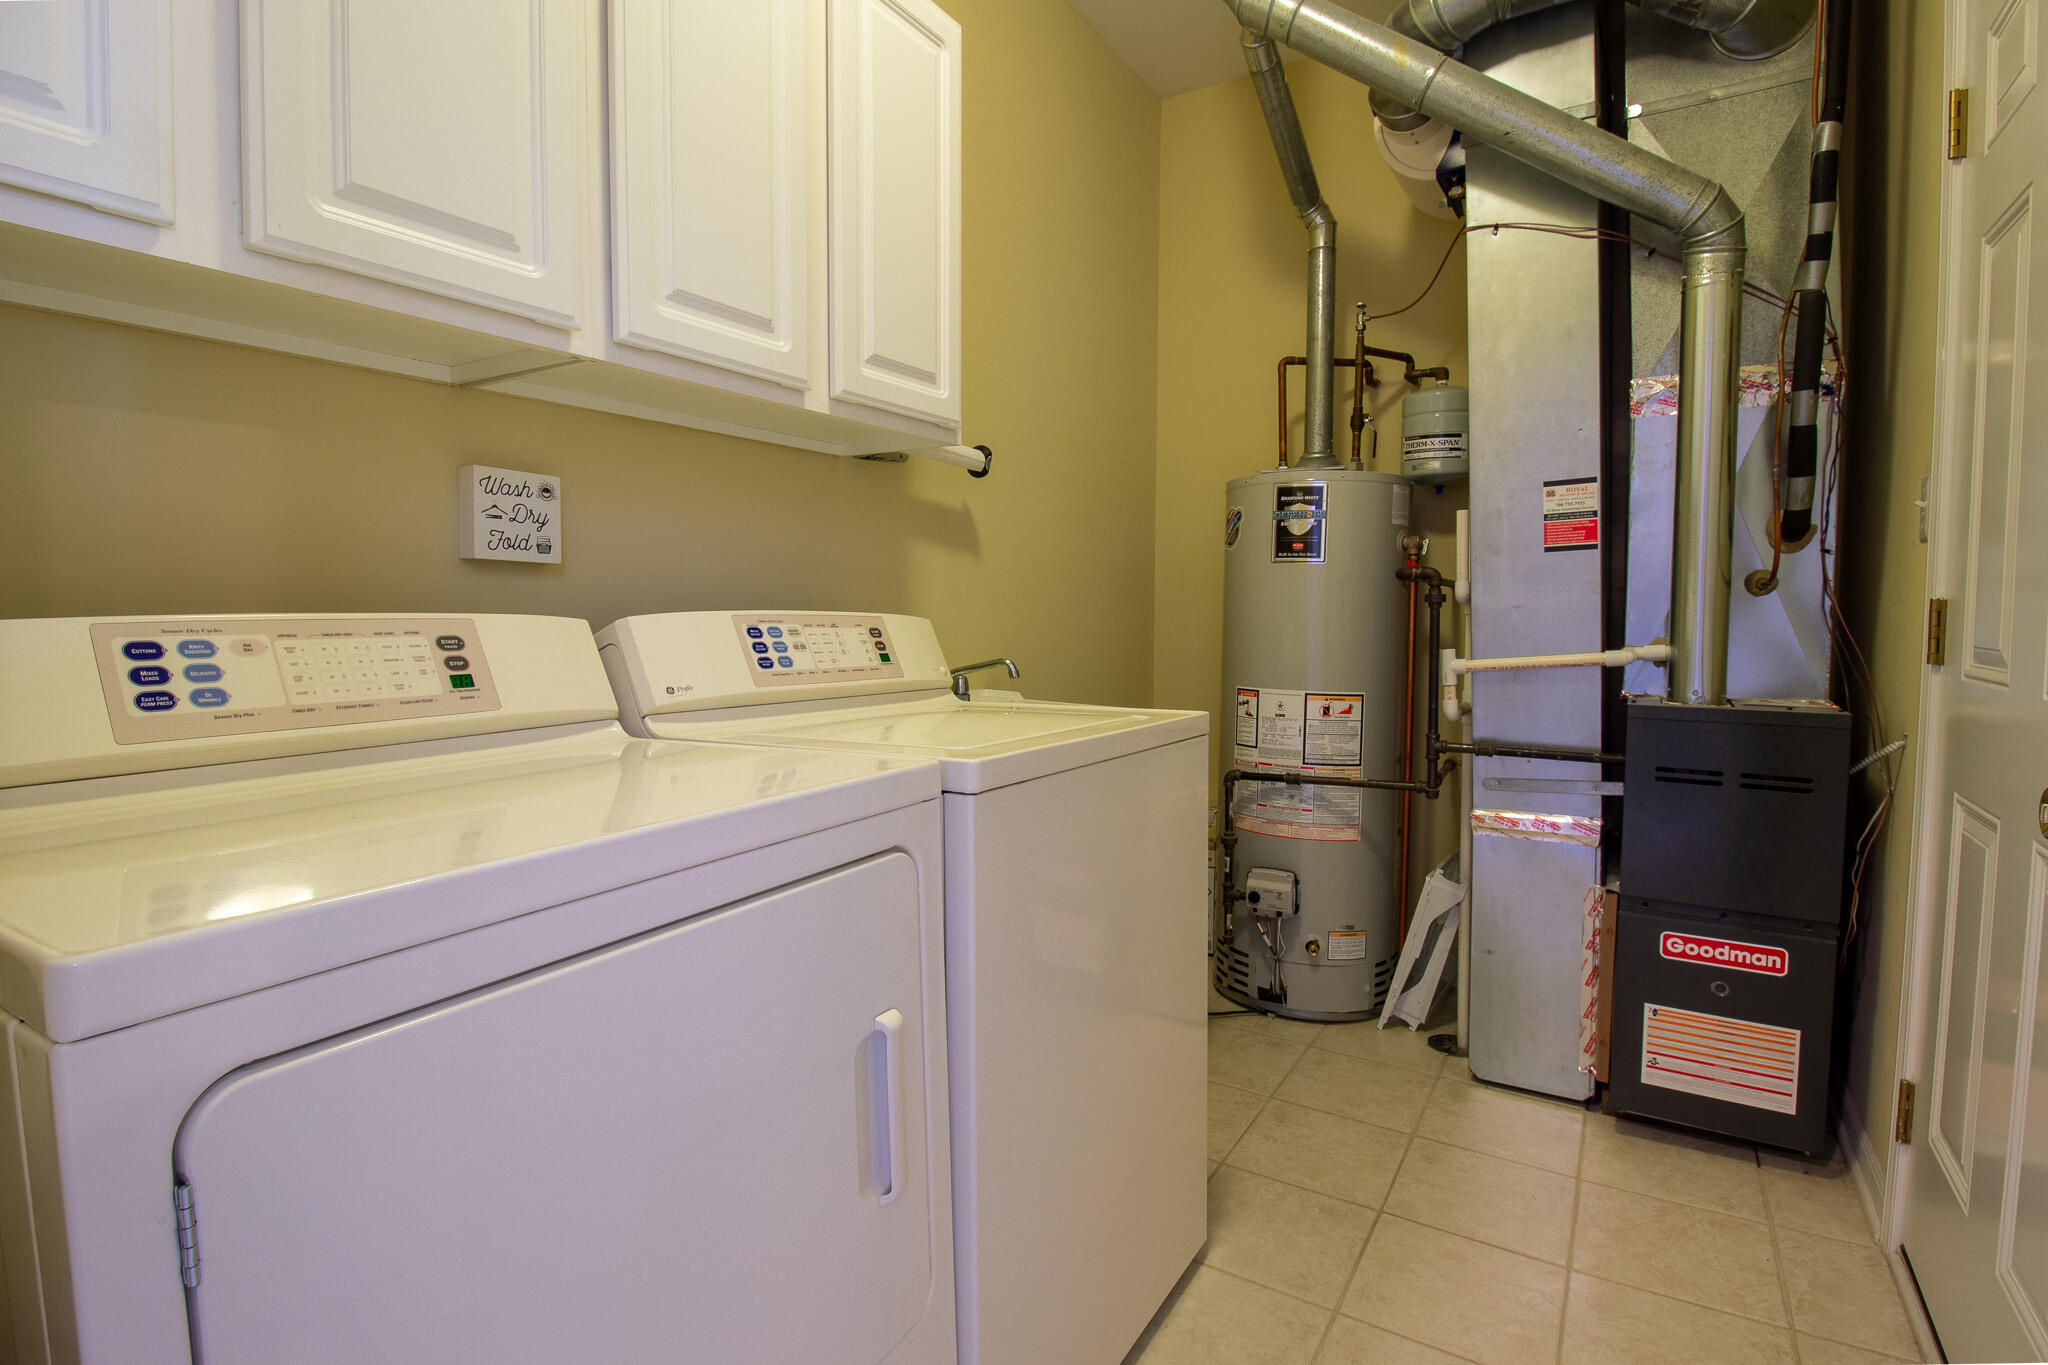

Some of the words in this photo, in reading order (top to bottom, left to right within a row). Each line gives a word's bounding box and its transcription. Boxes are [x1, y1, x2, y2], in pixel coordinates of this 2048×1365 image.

[479, 475, 533, 498] Wash
[509, 503, 549, 532] Dry
[487, 529, 533, 551] Fold
[1666, 937, 1781, 969] Goodman
